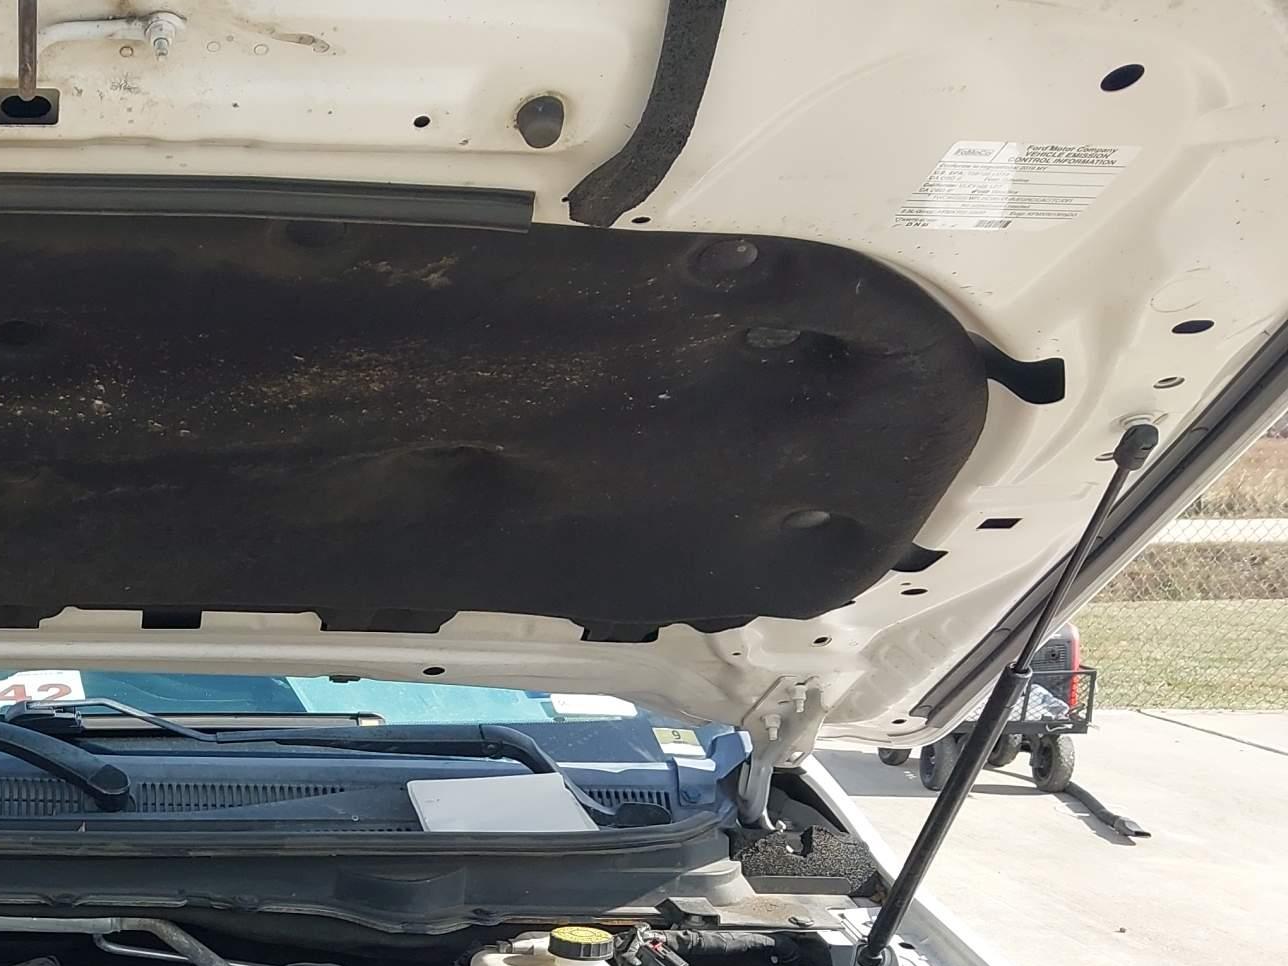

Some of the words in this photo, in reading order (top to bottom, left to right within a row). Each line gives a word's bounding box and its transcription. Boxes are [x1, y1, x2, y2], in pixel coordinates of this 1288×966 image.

[1077, 145, 1118, 154] Company
[1064, 151, 1111, 159] EMISSION
[1008, 156, 1051, 164] CONTROL
[1053, 157, 1116, 165] INFORMATION
[672, 730, 681, 740] 9
